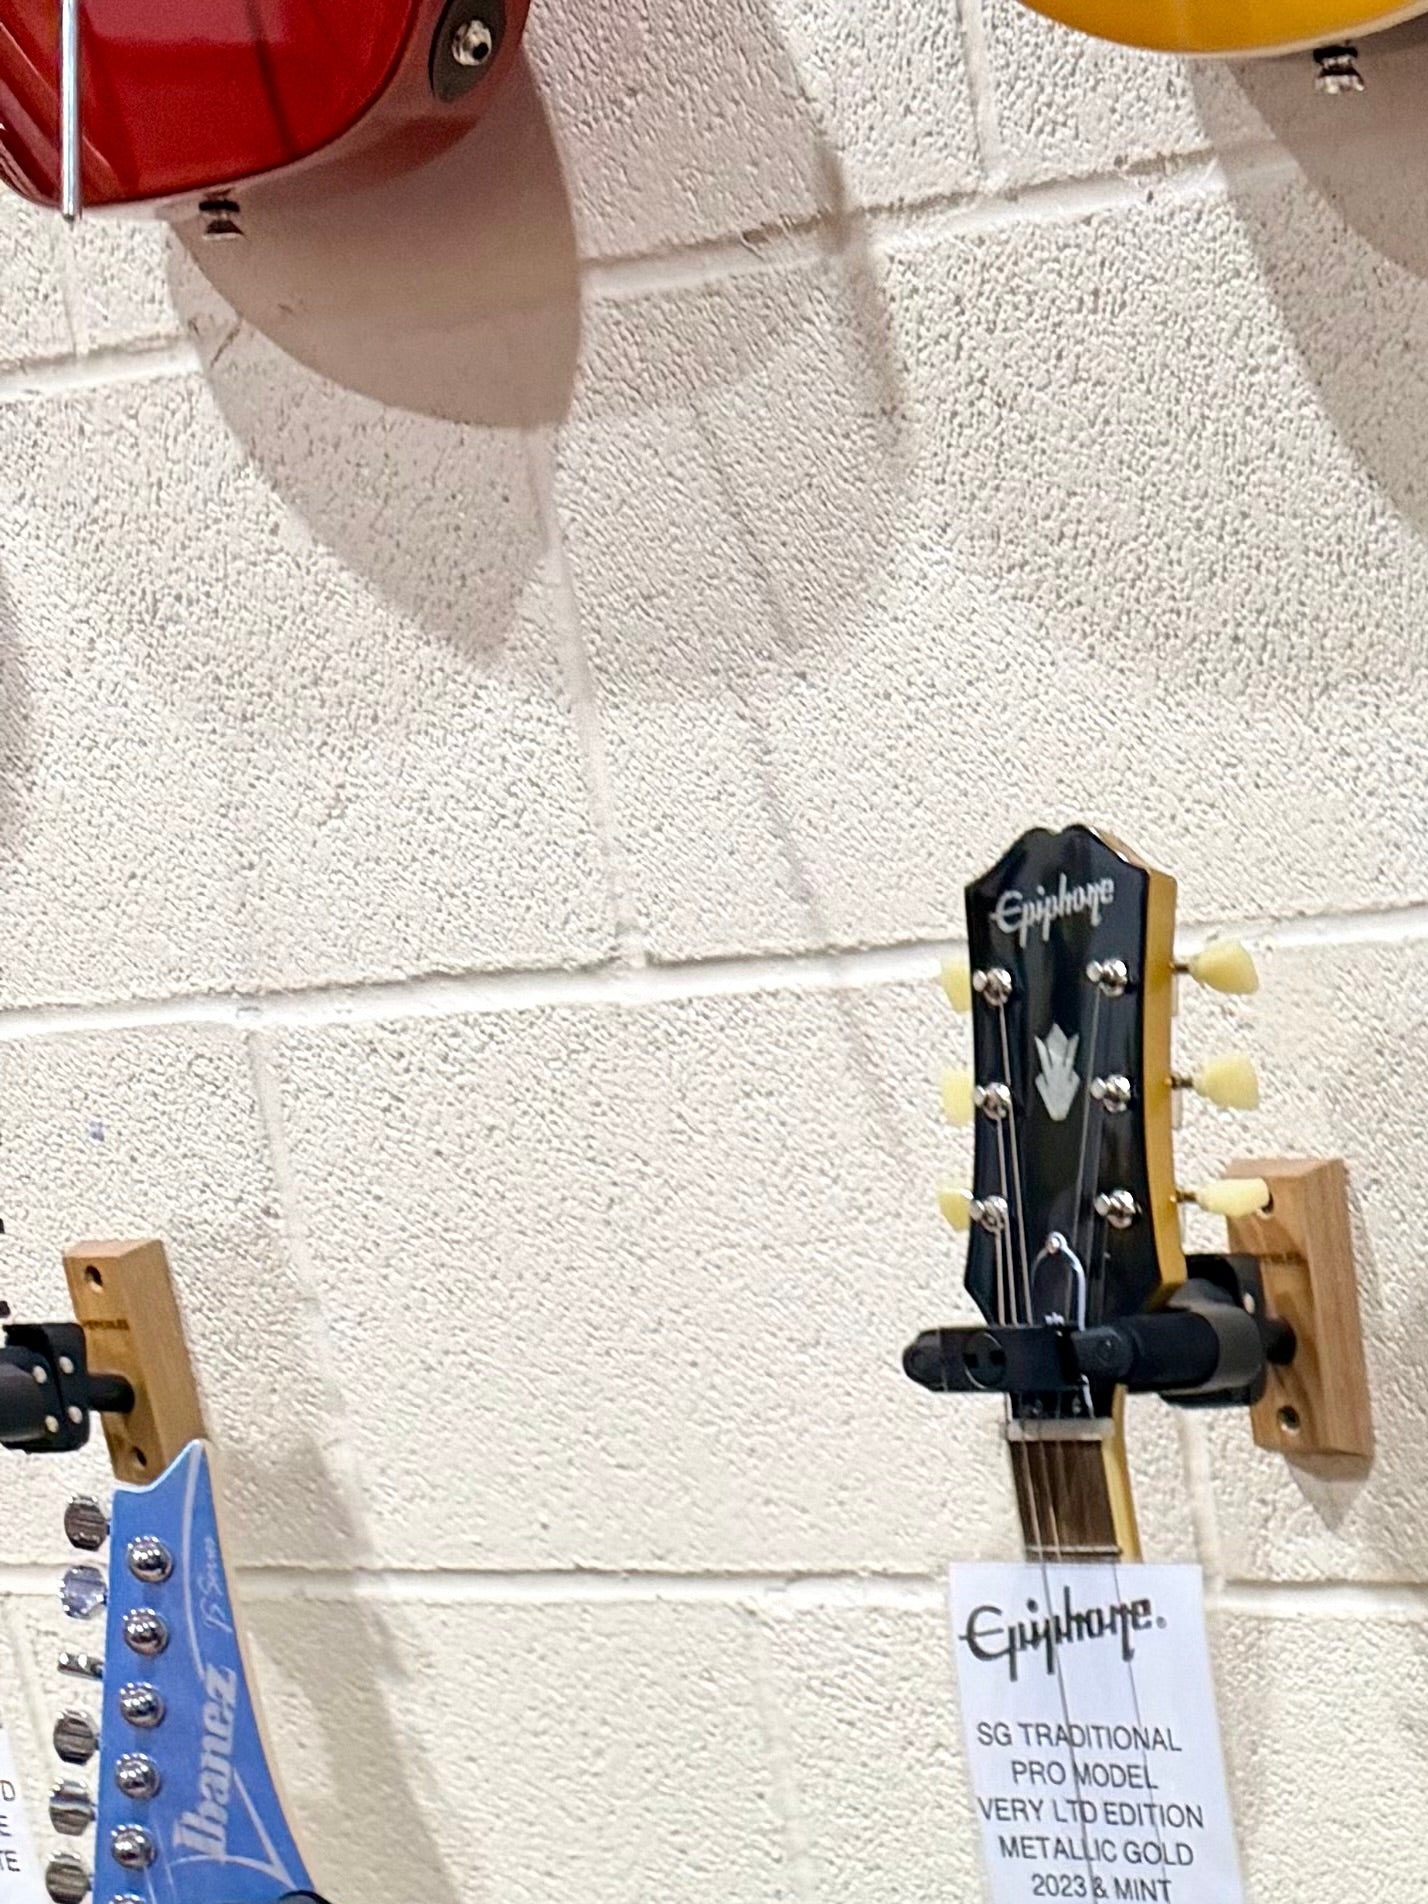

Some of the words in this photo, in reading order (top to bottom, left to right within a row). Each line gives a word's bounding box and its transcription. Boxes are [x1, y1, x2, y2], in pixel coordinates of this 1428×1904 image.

[990, 872, 1116, 948] Epiphone
[958, 1585, 1155, 1683] Epiphone
[976, 1722, 1013, 1747] SG
[1017, 1723, 1183, 1753] TRADITIONAL
[172, 1662, 238, 1866] Ibanez
[1011, 1761, 1067, 1786] PRO
[1072, 1763, 1160, 1790] MODEL
[978, 1797, 1044, 1824] VERY
[1053, 1799, 1099, 1824] LTD
[1103, 1800, 1205, 1829] EDITION
[998, 1835, 1119, 1865] METALLIC
[1122, 1840, 1195, 1868] GOLD
[1031, 1873, 1089, 1899] 2023
[1092, 1876, 1111, 1900] &
[1115, 1876, 1173, 1902] MINT
